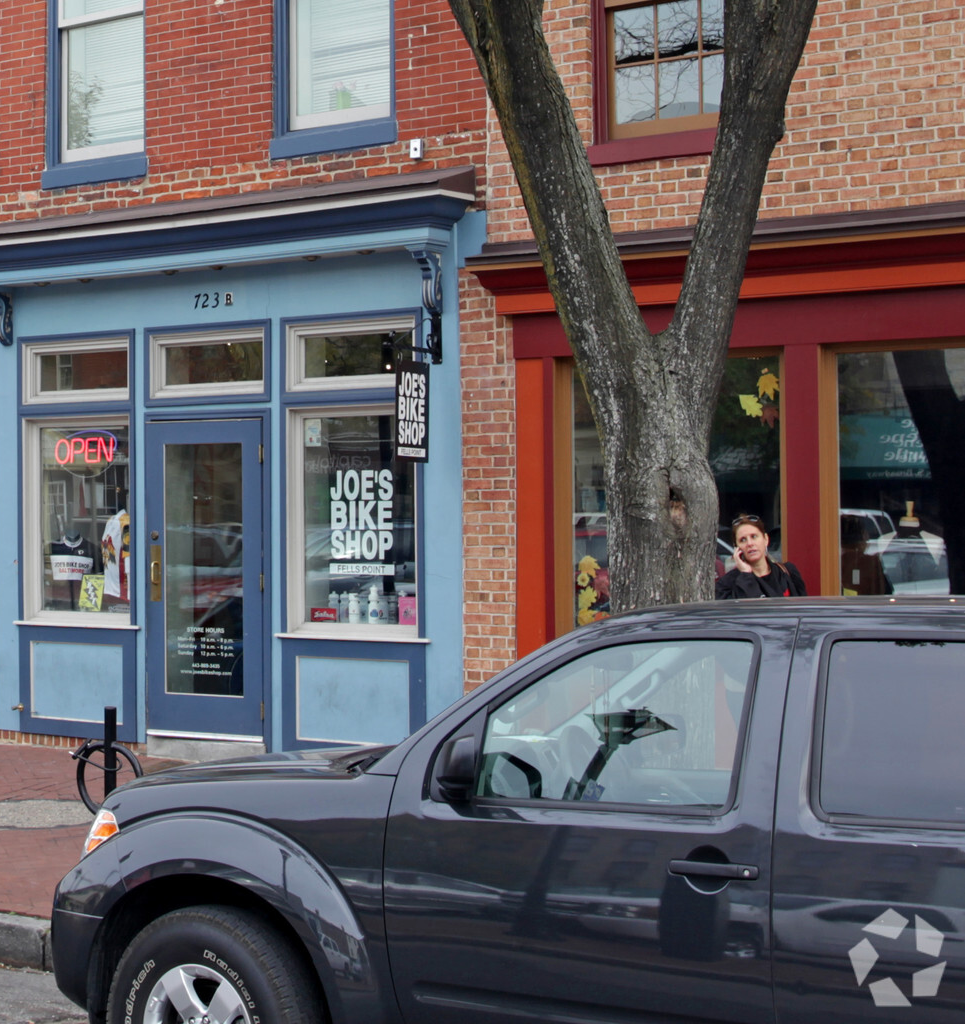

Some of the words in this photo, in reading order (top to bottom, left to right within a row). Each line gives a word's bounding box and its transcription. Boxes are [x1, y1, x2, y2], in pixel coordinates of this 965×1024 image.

[194, 292, 220, 310] 723
[225, 293, 232, 305] B
[398, 371, 426, 399] JOE'S
[398, 396, 426, 423] BIKE
[398, 420, 426, 446] SHOP
[54, 437, 114, 465] OPEN
[330, 469, 394, 501] JOE'S
[330, 500, 394, 531] BIKE
[330, 530, 394, 560] SHOP
[337, 564, 360, 574] FELLS
[362, 564, 386, 574] POINT
[203, 949, 256, 1009] Radial
